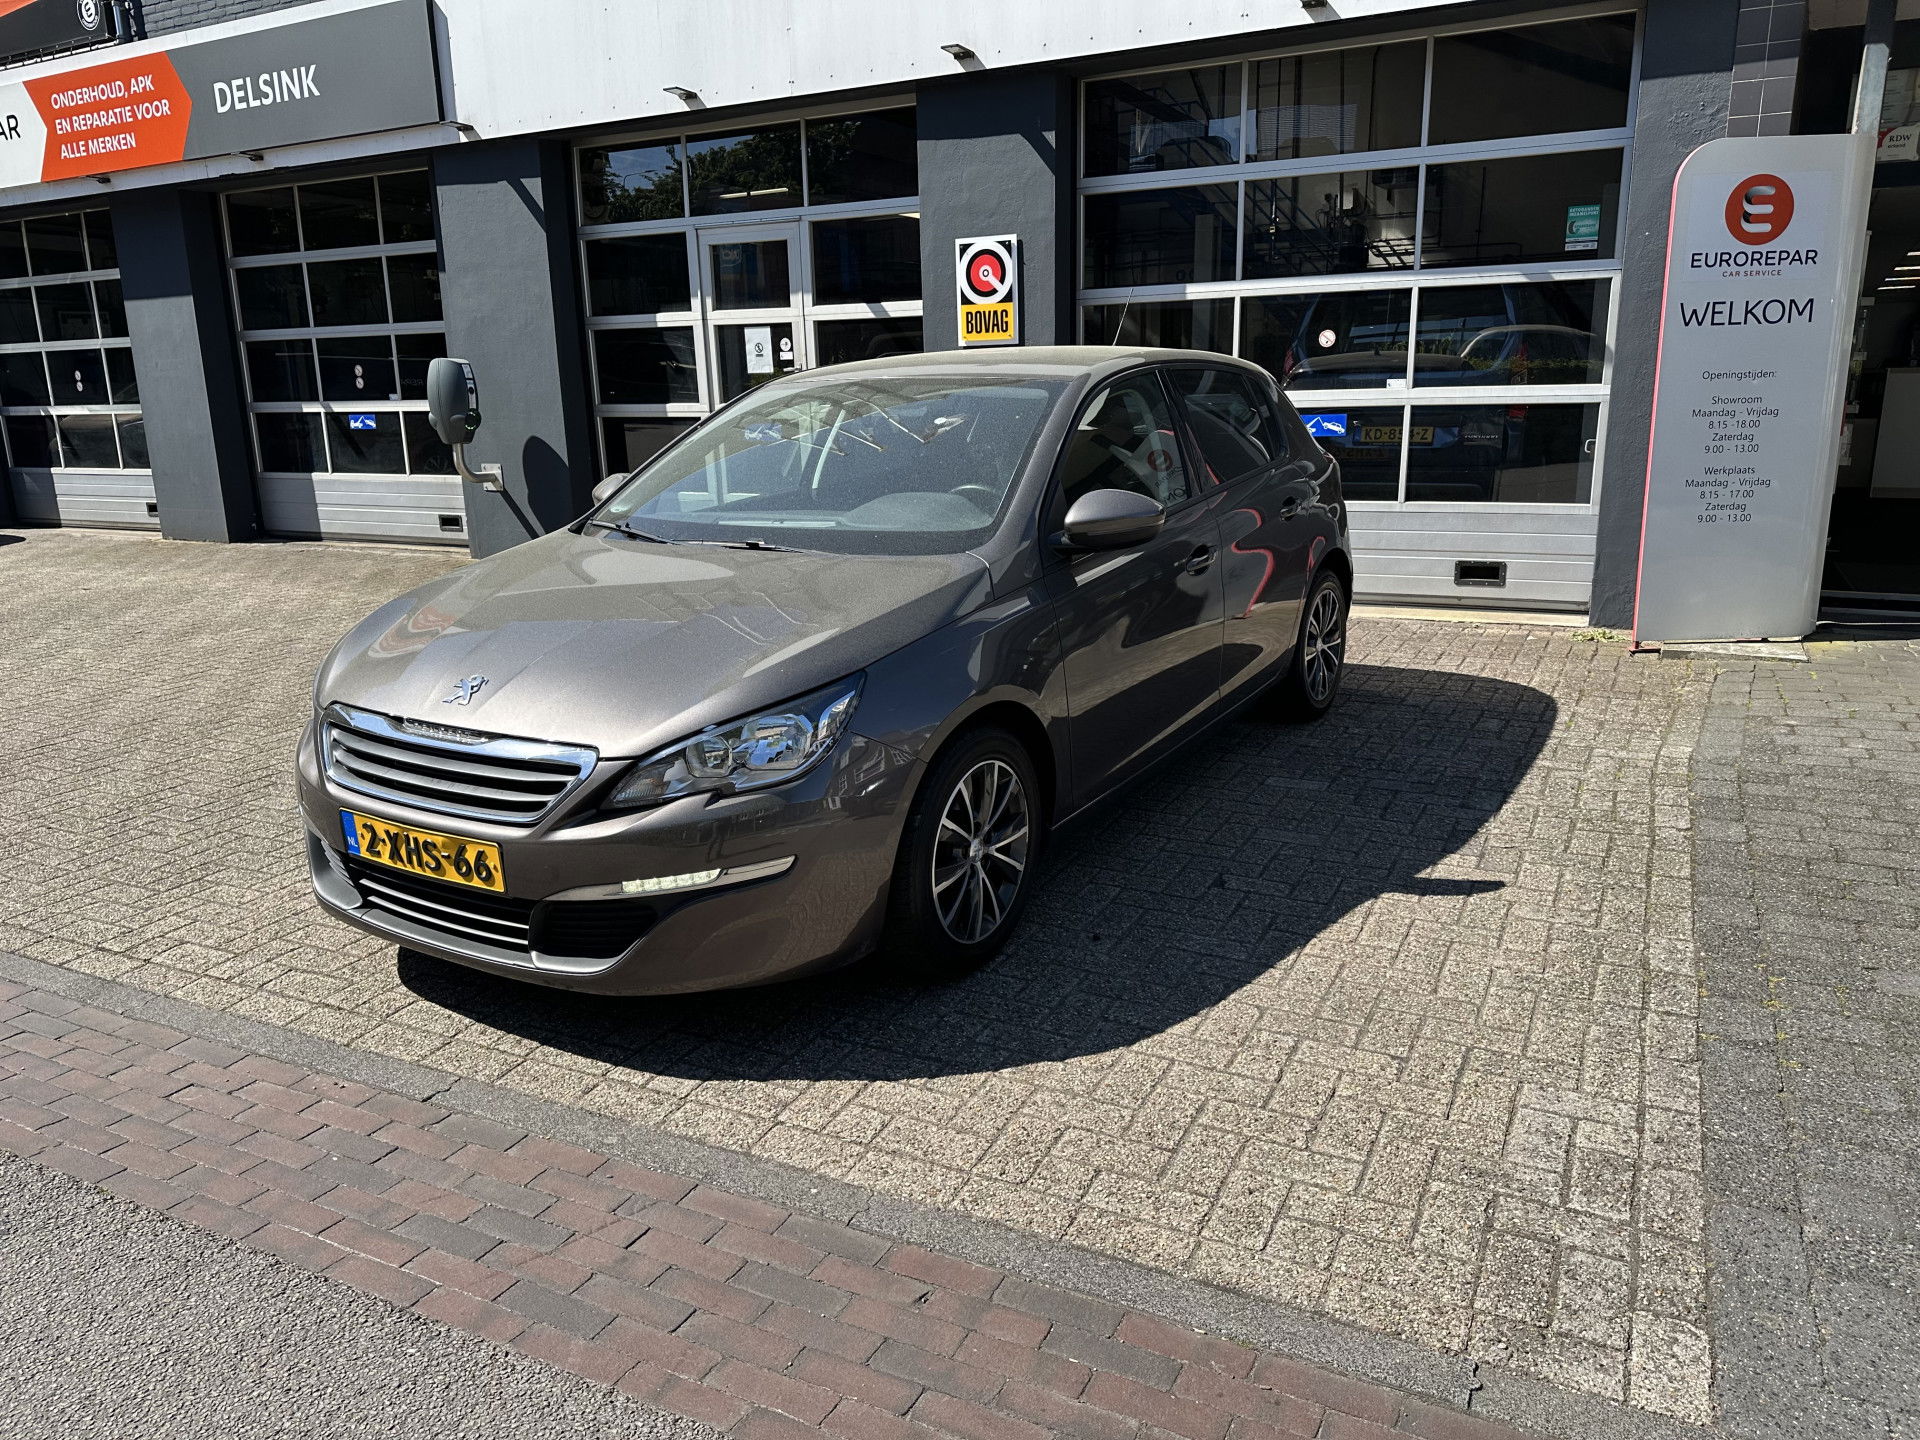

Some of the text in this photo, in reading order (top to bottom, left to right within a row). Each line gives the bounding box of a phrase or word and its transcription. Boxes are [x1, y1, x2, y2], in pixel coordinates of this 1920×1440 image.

[51, 74, 155, 109] ONDERHOUD, APK
[212, 64, 321, 113] DELSINK
[55, 99, 171, 135] EN REPARATIE VOOR
[1889, 134, 1912, 142] RDW
[61, 132, 137, 160] ALLE MERKEN
[1690, 249, 1818, 268] EUROREPAR
[1722, 269, 1782, 278] CAR SERVICE
[1680, 298, 1815, 327] WELKOM
[965, 309, 1009, 334] BOVAG
[1711, 395, 1763, 405] Showroom
[1692, 408, 1736, 418] Maandag
[1746, 406, 1779, 418] Vrijdag
[1712, 432, 1754, 442] Zaterdag
[1704, 466, 1756, 477] Werkplaats
[1685, 478, 1729, 489] Maandag
[1738, 477, 1771, 488] Vrijdag
[1705, 501, 1747, 512] Zaterdag
[347, 822, 493, 882] NL 2-XHS-66
